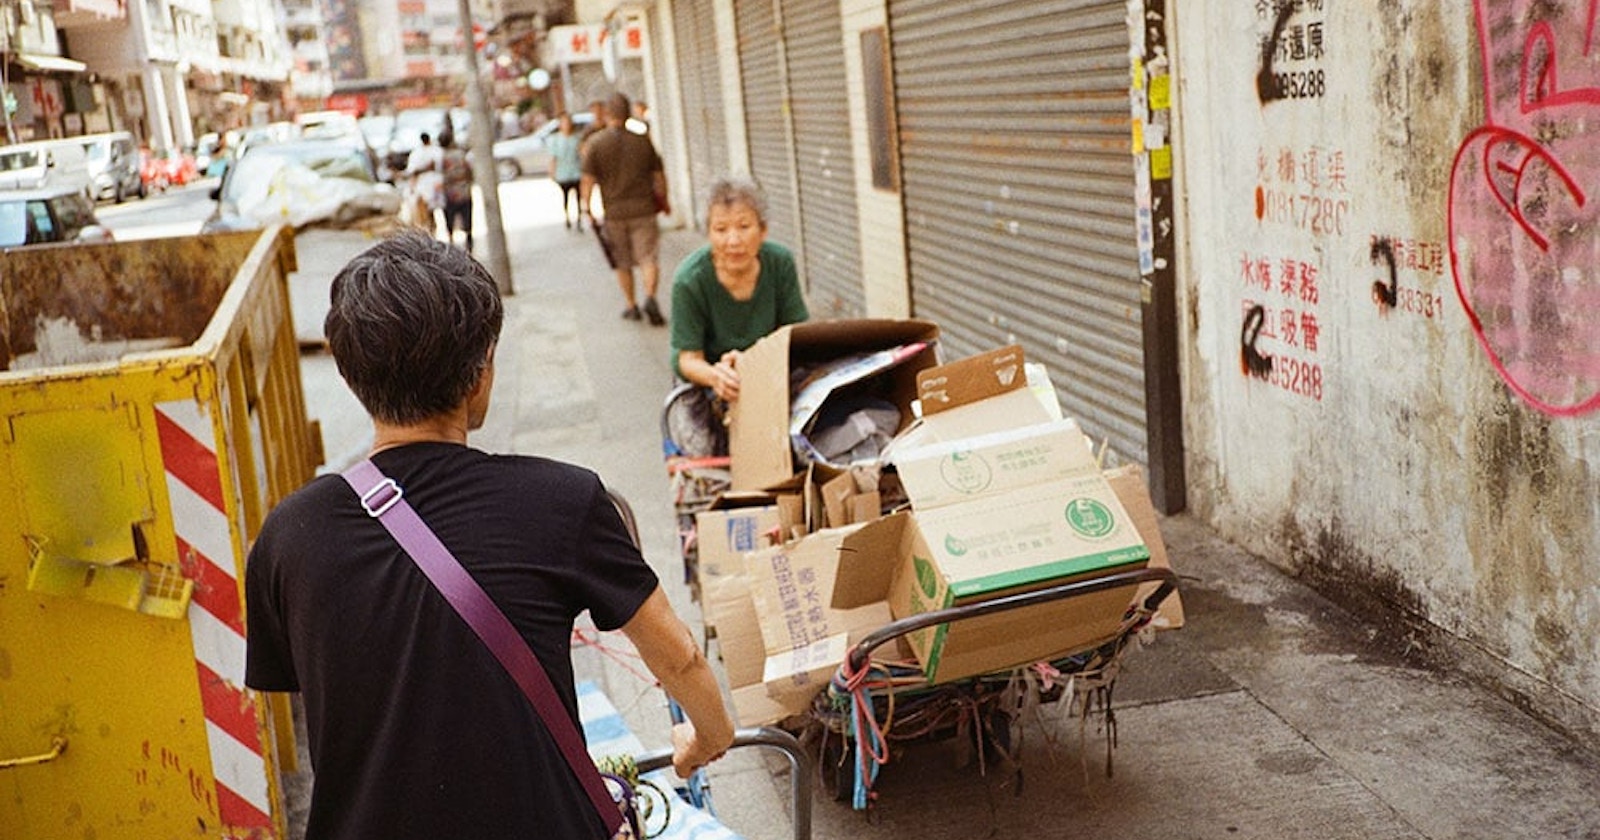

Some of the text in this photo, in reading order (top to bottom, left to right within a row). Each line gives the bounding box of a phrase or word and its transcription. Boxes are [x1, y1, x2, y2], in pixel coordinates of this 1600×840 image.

[1256, 22, 1324, 62] 拆還原
[1257, 70, 1325, 100] 95288
[1255, 186, 1348, 237] 0817280
[1242, 349, 1323, 401] 95288
